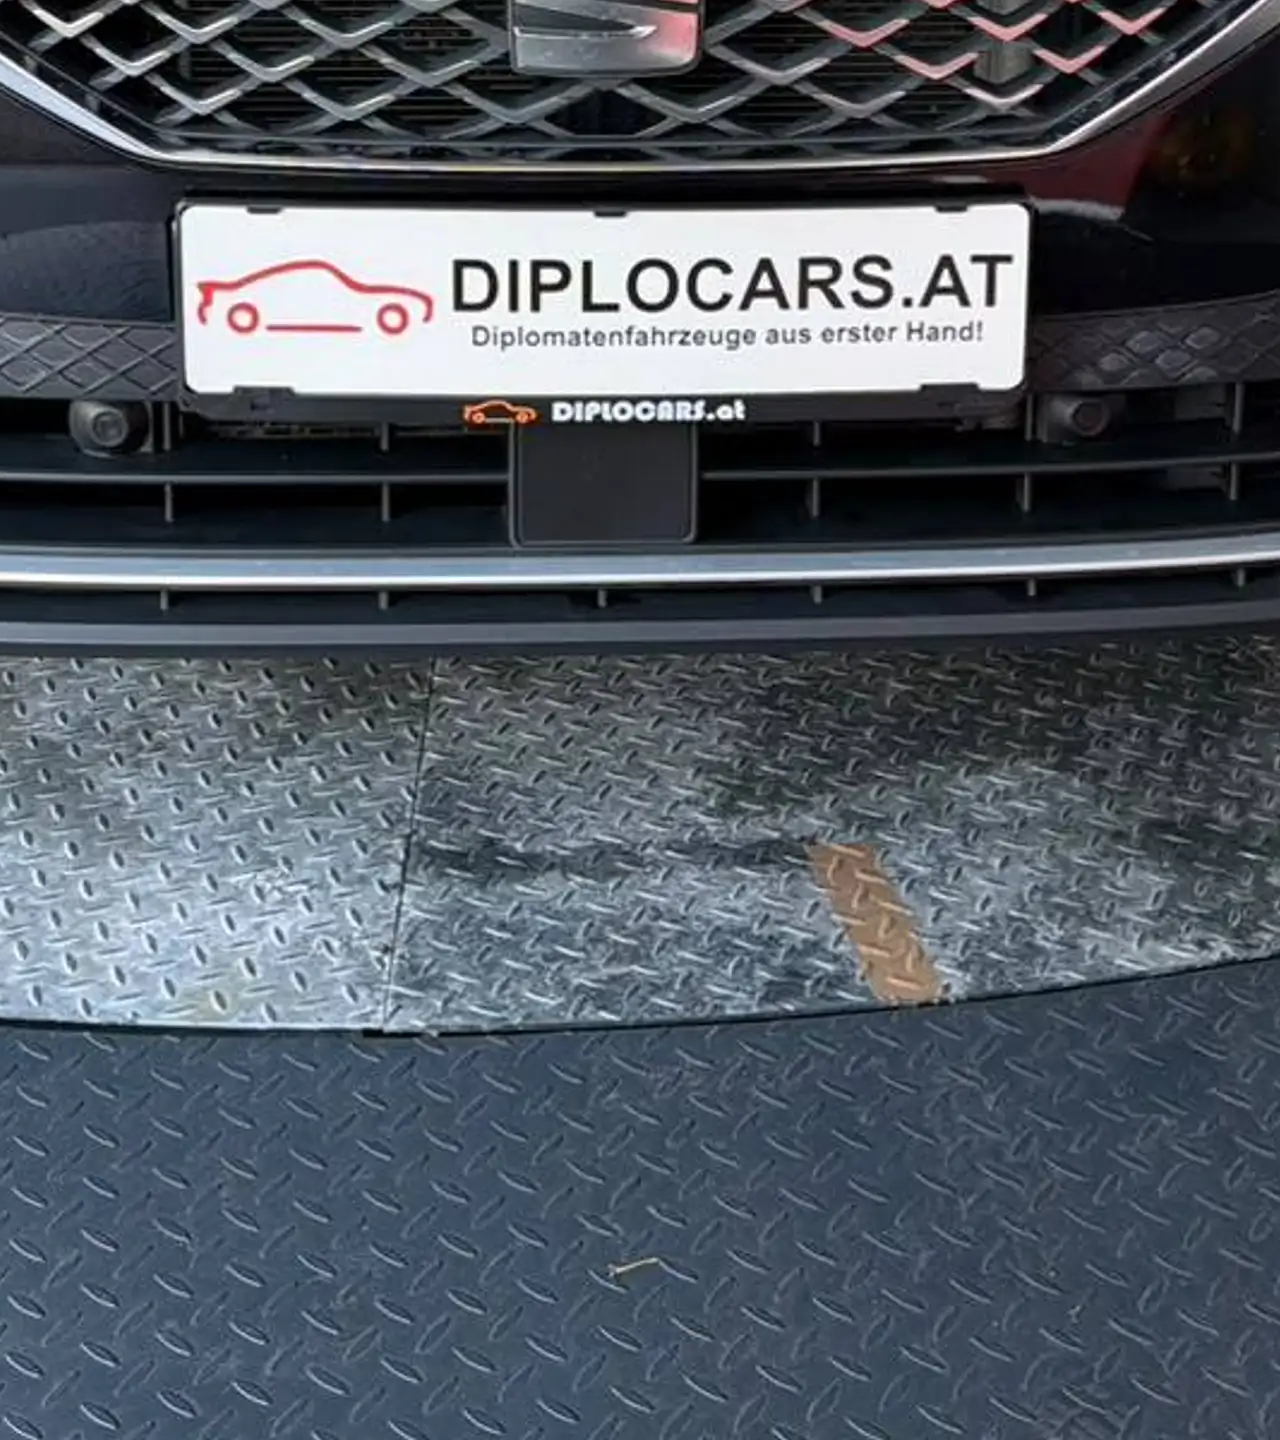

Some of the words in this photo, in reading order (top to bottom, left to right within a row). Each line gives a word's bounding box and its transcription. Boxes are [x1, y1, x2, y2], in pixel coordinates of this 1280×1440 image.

[451, 253, 1014, 313] DIPLOCARS.AT
[471, 324, 757, 351] Diplomatenfahrzeuge
[764, 326, 812, 345] aus
[820, 323, 896, 343] erster
[906, 321, 984, 343] Hand!
[551, 399, 746, 424] DIPLOCARS.at
